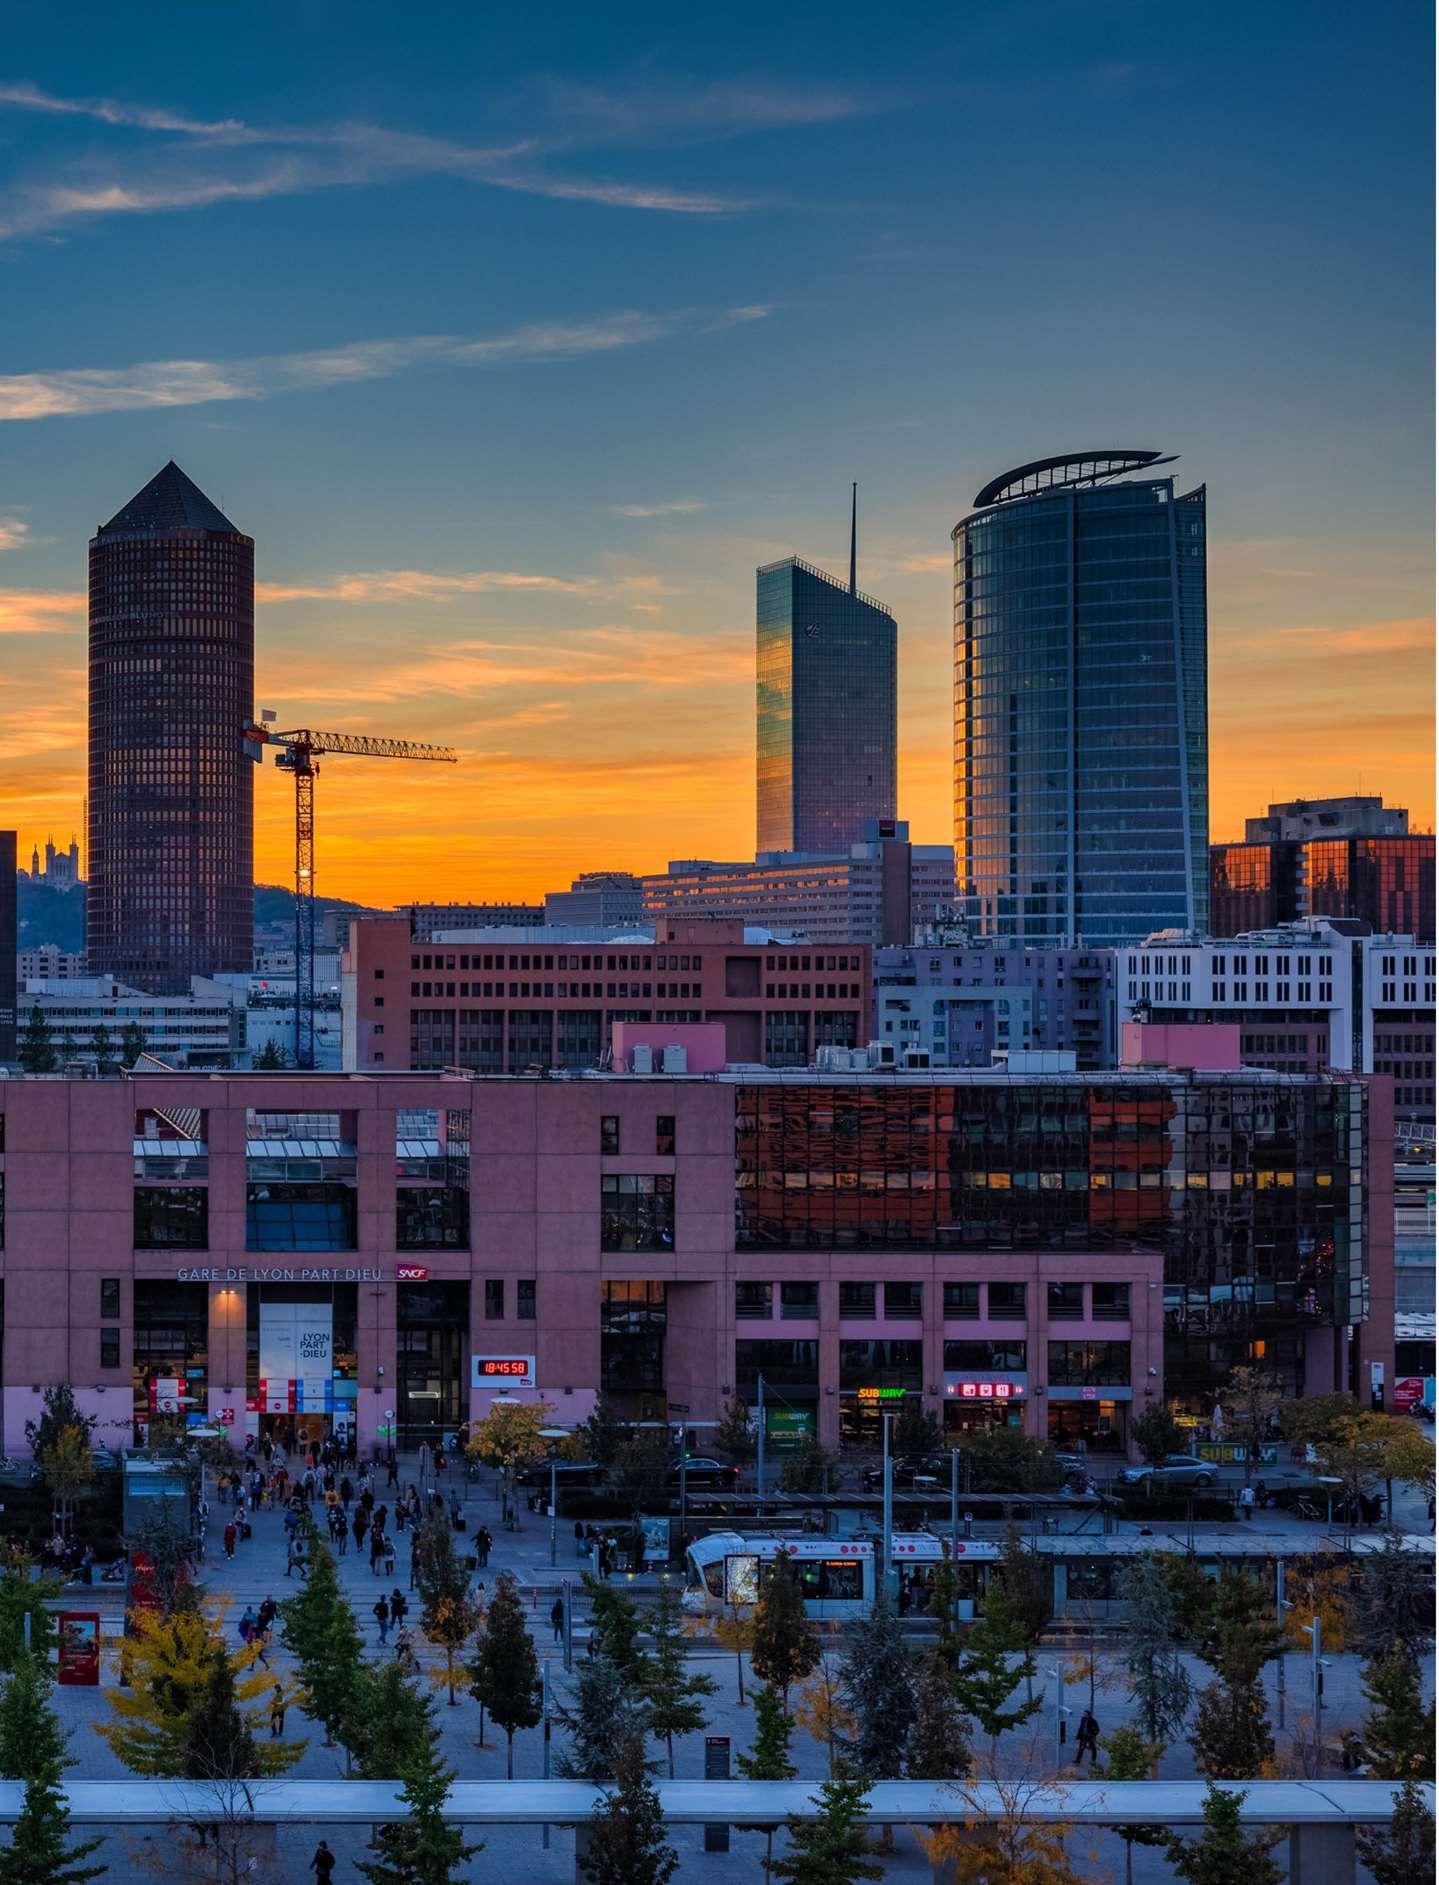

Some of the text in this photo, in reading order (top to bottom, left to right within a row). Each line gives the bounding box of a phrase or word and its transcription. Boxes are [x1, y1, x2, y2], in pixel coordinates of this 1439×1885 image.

[177, 1268, 382, 1280] GARE DE LYON PART-DIEU
[397, 1268, 427, 1279] SNCF
[303, 1333, 330, 1342] LYON
[300, 1341, 325, 1349] PART
[858, 1387, 907, 1399] SUBWAY
[773, 1412, 810, 1420] SUBWAY
[1199, 1447, 1276, 1462] SUBWY
